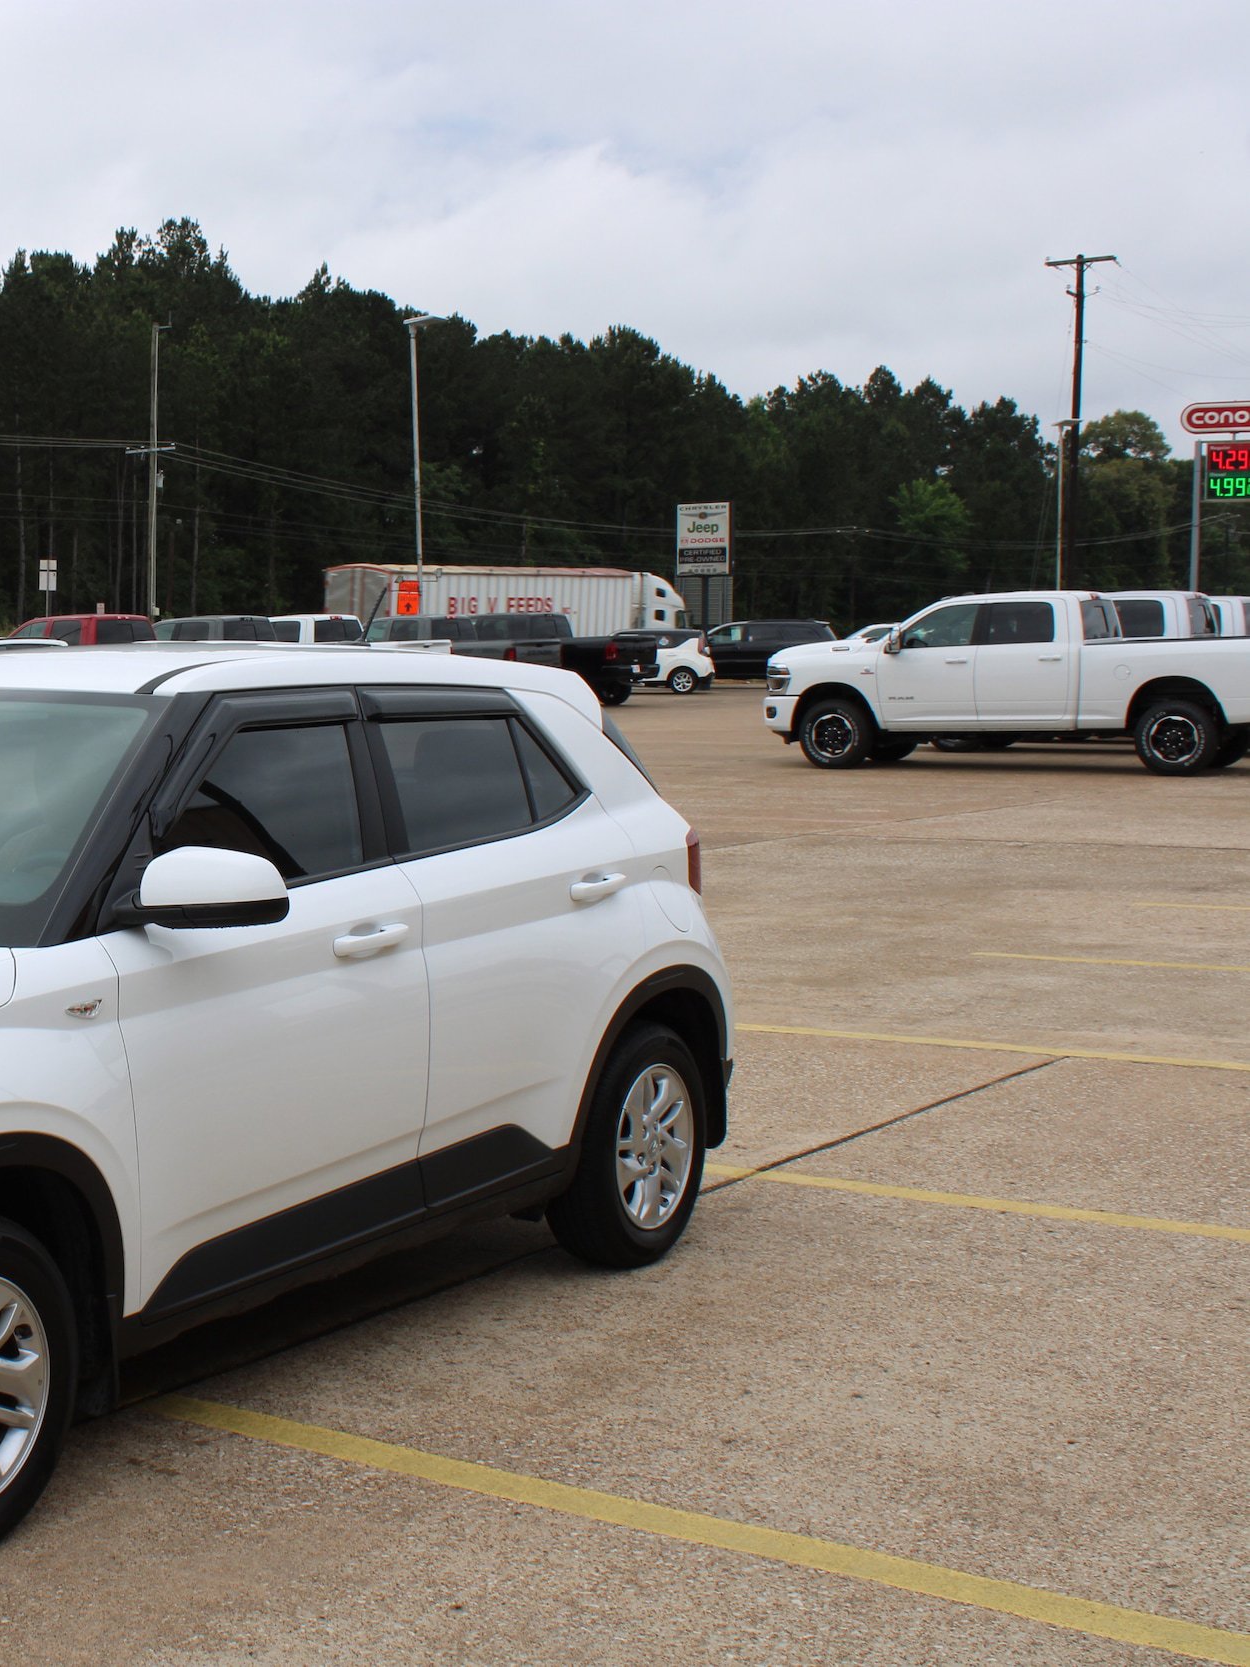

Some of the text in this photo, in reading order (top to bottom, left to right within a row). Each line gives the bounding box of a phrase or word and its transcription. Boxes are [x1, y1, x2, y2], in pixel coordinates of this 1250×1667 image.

[1212, 450, 1248, 469] 4.29
[687, 521, 719, 535] Jeep
[447, 597, 478, 614] BIG
[506, 596, 553, 613] FEEDS
